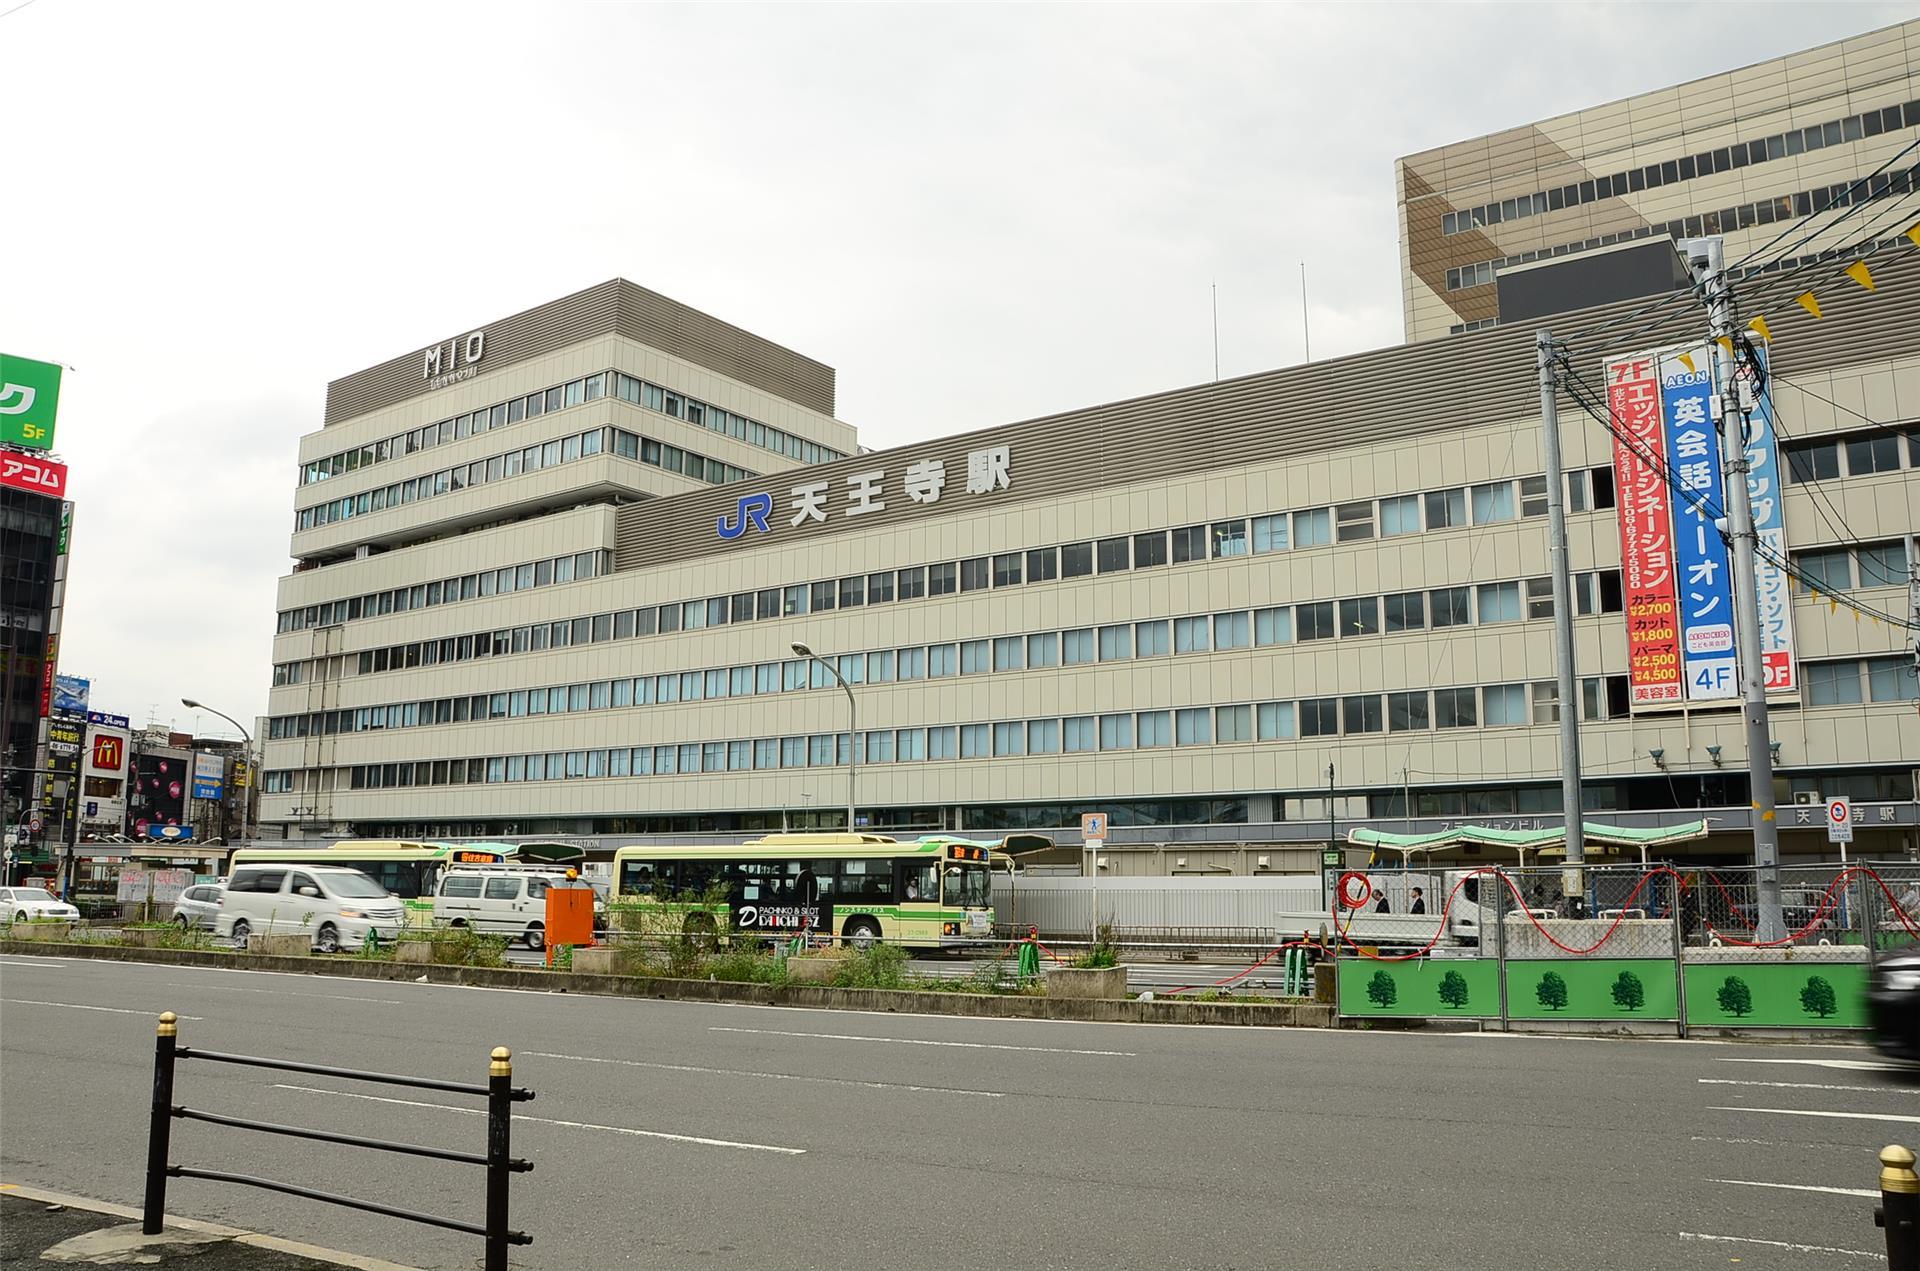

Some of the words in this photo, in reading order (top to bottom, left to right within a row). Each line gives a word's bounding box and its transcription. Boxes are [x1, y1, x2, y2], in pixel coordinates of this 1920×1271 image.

[424, 331, 484, 379] MIO
[1611, 359, 1651, 383] 7F
[1666, 371, 1708, 388] AEON
[23, 423, 46, 440] 5F
[3, 459, 60, 488] アコム
[717, 492, 773, 540] JR
[790, 445, 1012, 528] 天王寺駅
[1632, 594, 1670, 606] カラー
[1635, 618, 1670, 631] カット
[1635, 643, 1674, 656] パーマ
[1696, 668, 1730, 690] 4F
[1635, 685, 1680, 700] 美容室
[1797, 807, 1895, 823] 天寺駅
[1440, 820, 1545, 832] ステションビル
[759, 906, 793, 914] PACHINKO
